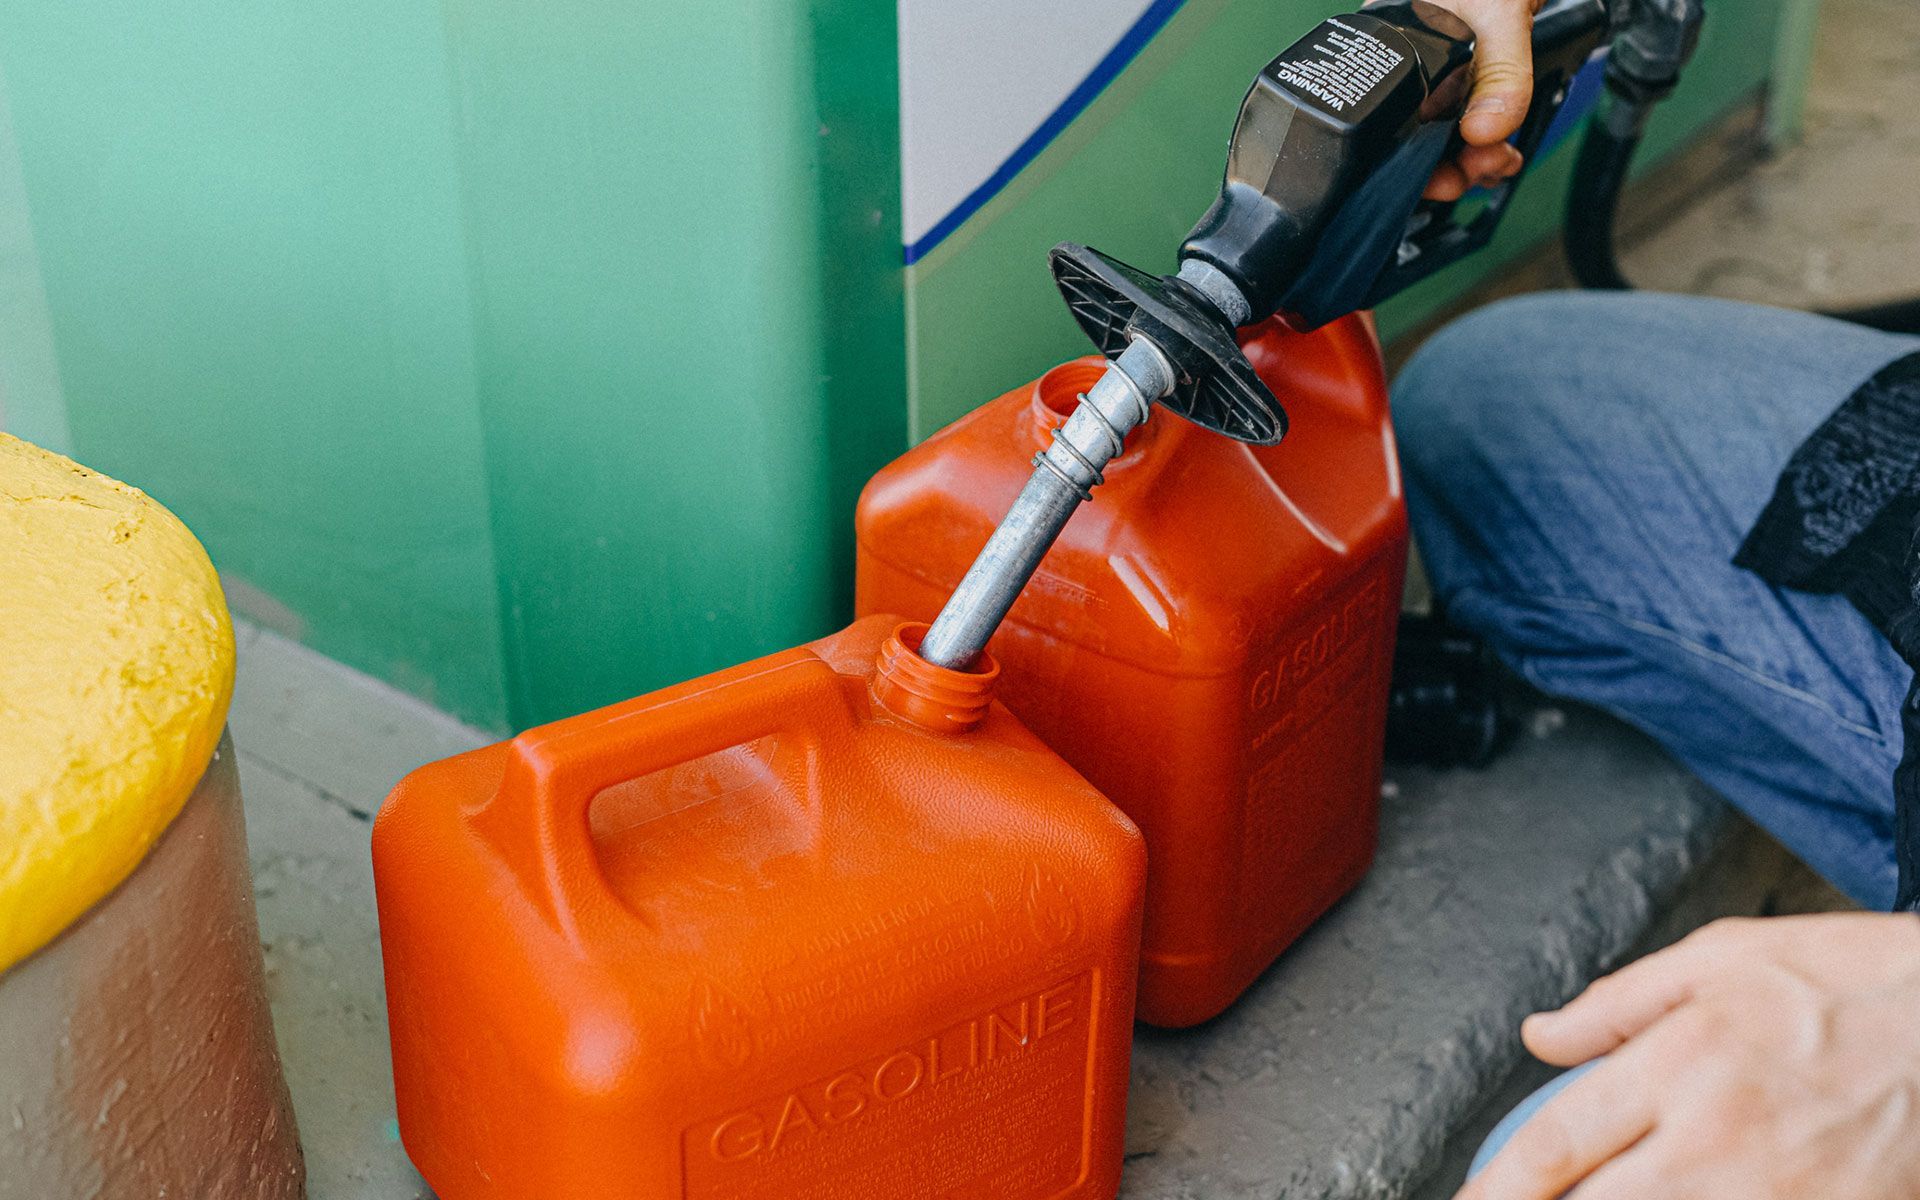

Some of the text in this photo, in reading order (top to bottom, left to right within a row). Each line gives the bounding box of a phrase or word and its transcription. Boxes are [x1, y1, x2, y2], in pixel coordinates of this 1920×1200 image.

[1327, 18, 1356, 32] warnings
[1343, 38, 1365, 50] drivers
[1355, 30, 1380, 44] posted
[1334, 54, 1359, 69] remove
[1346, 52, 1374, 71] smoking
[1364, 49, 1394, 69] Licensed
[1385, 48, 1404, 61] Refer
[1279, 61, 1299, 72] cause
[1292, 60, 1322, 76] condition
[1307, 61, 1330, 74] hazard
[1335, 60, 1346, 69] fire
[1278, 69, 1343, 110] WARNING
[1322, 75, 1355, 97] hazardous
[1345, 82, 1366, 96] Avoid
[1348, 76, 1370, 92] remain
[1326, 85, 1356, 106] Improper
[711, 982, 1074, 1164] GASOLINE
